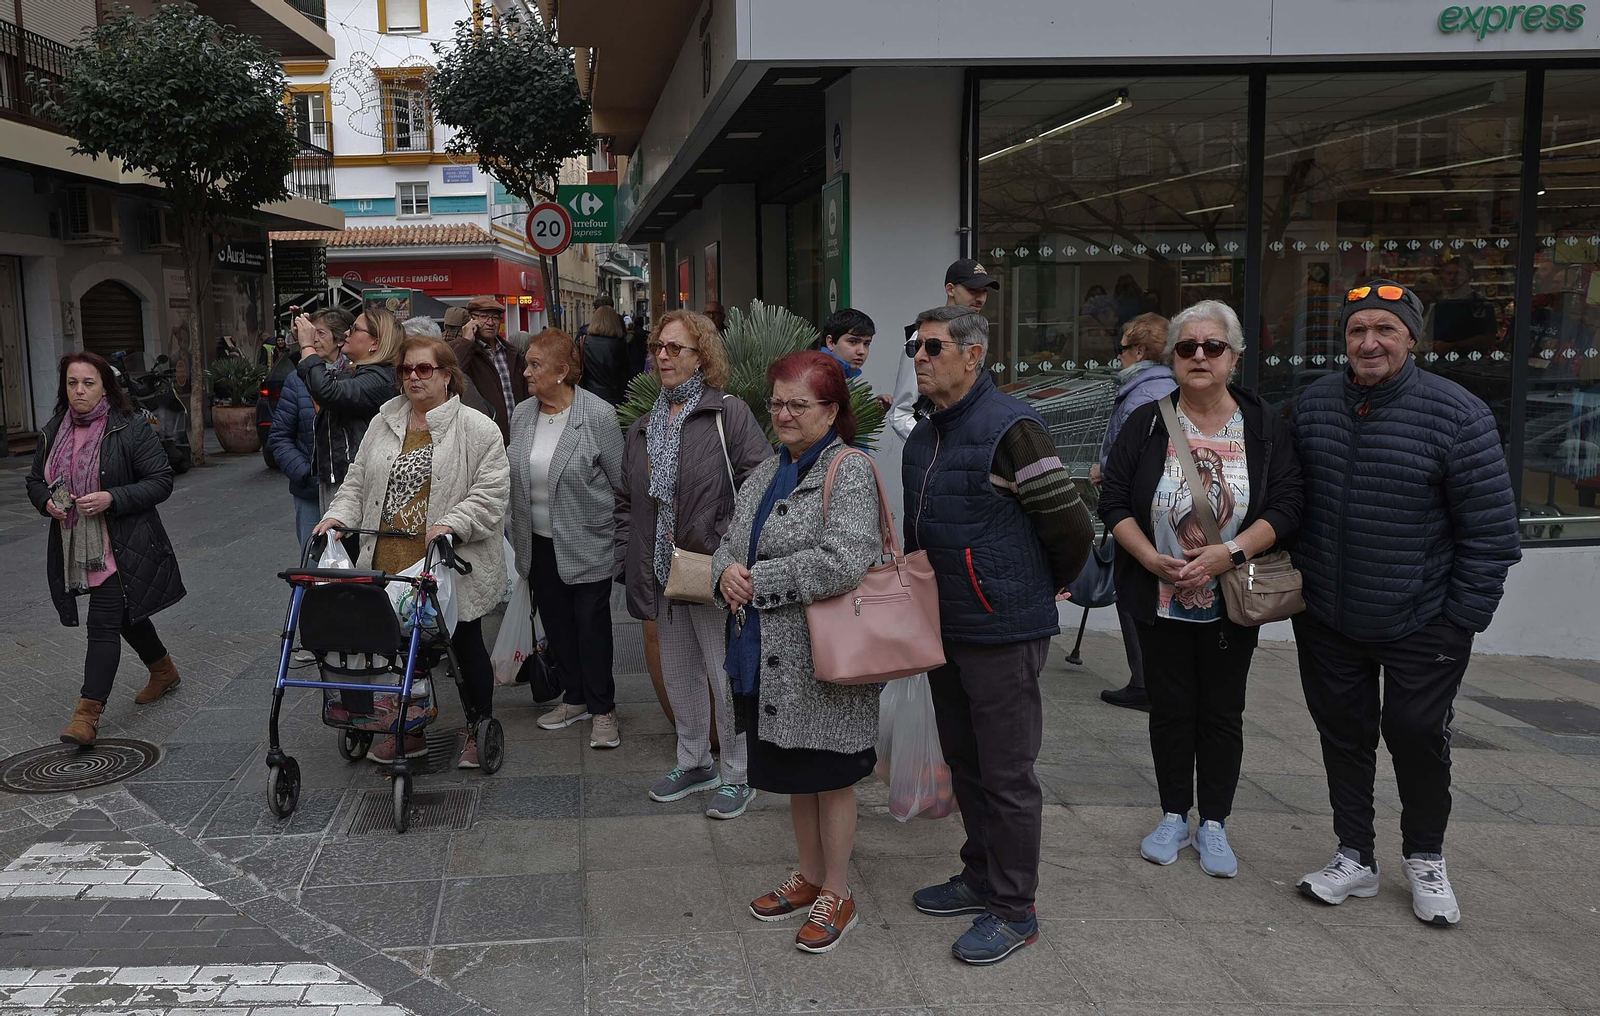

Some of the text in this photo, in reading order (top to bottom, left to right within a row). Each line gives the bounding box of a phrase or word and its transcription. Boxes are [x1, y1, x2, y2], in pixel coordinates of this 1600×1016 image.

[1438, 4, 1586, 42] express
[537, 220, 560, 237] 20
[573, 219, 608, 228] arrefour
[227, 244, 246, 264] Aural
[375, 276, 405, 284] GIGANTE
[411, 274, 449, 283] EMPEÑOS
[400, 497, 428, 526] furry
